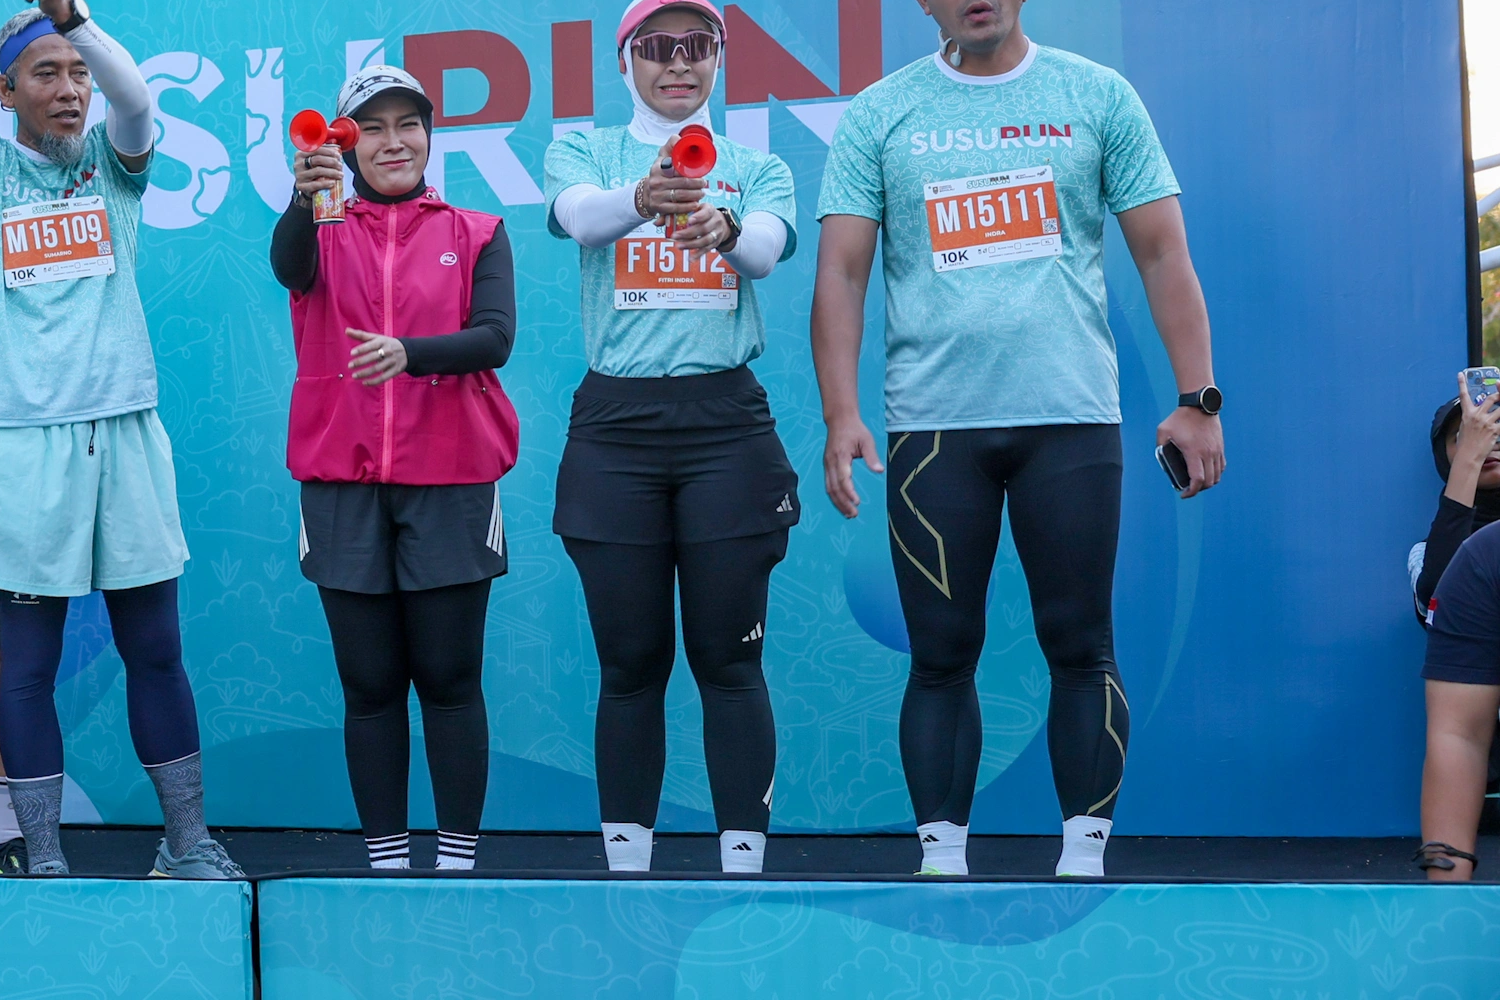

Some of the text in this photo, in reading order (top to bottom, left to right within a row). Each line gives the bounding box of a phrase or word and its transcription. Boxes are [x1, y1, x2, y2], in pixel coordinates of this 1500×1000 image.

[910, 123, 1073, 155] SUSURUN
[966, 175, 1011, 190] SUSURUN
[32, 202, 70, 214] SUSURUN
[935, 186, 1047, 234] M15111
[5, 214, 103, 254] M15109
[984, 230, 1007, 239] INDRA
[43, 250, 73, 258] SUMARNO
[941, 249, 970, 264] 10K
[11, 268, 36, 281] 10K
[622, 291, 649, 303] 10K
